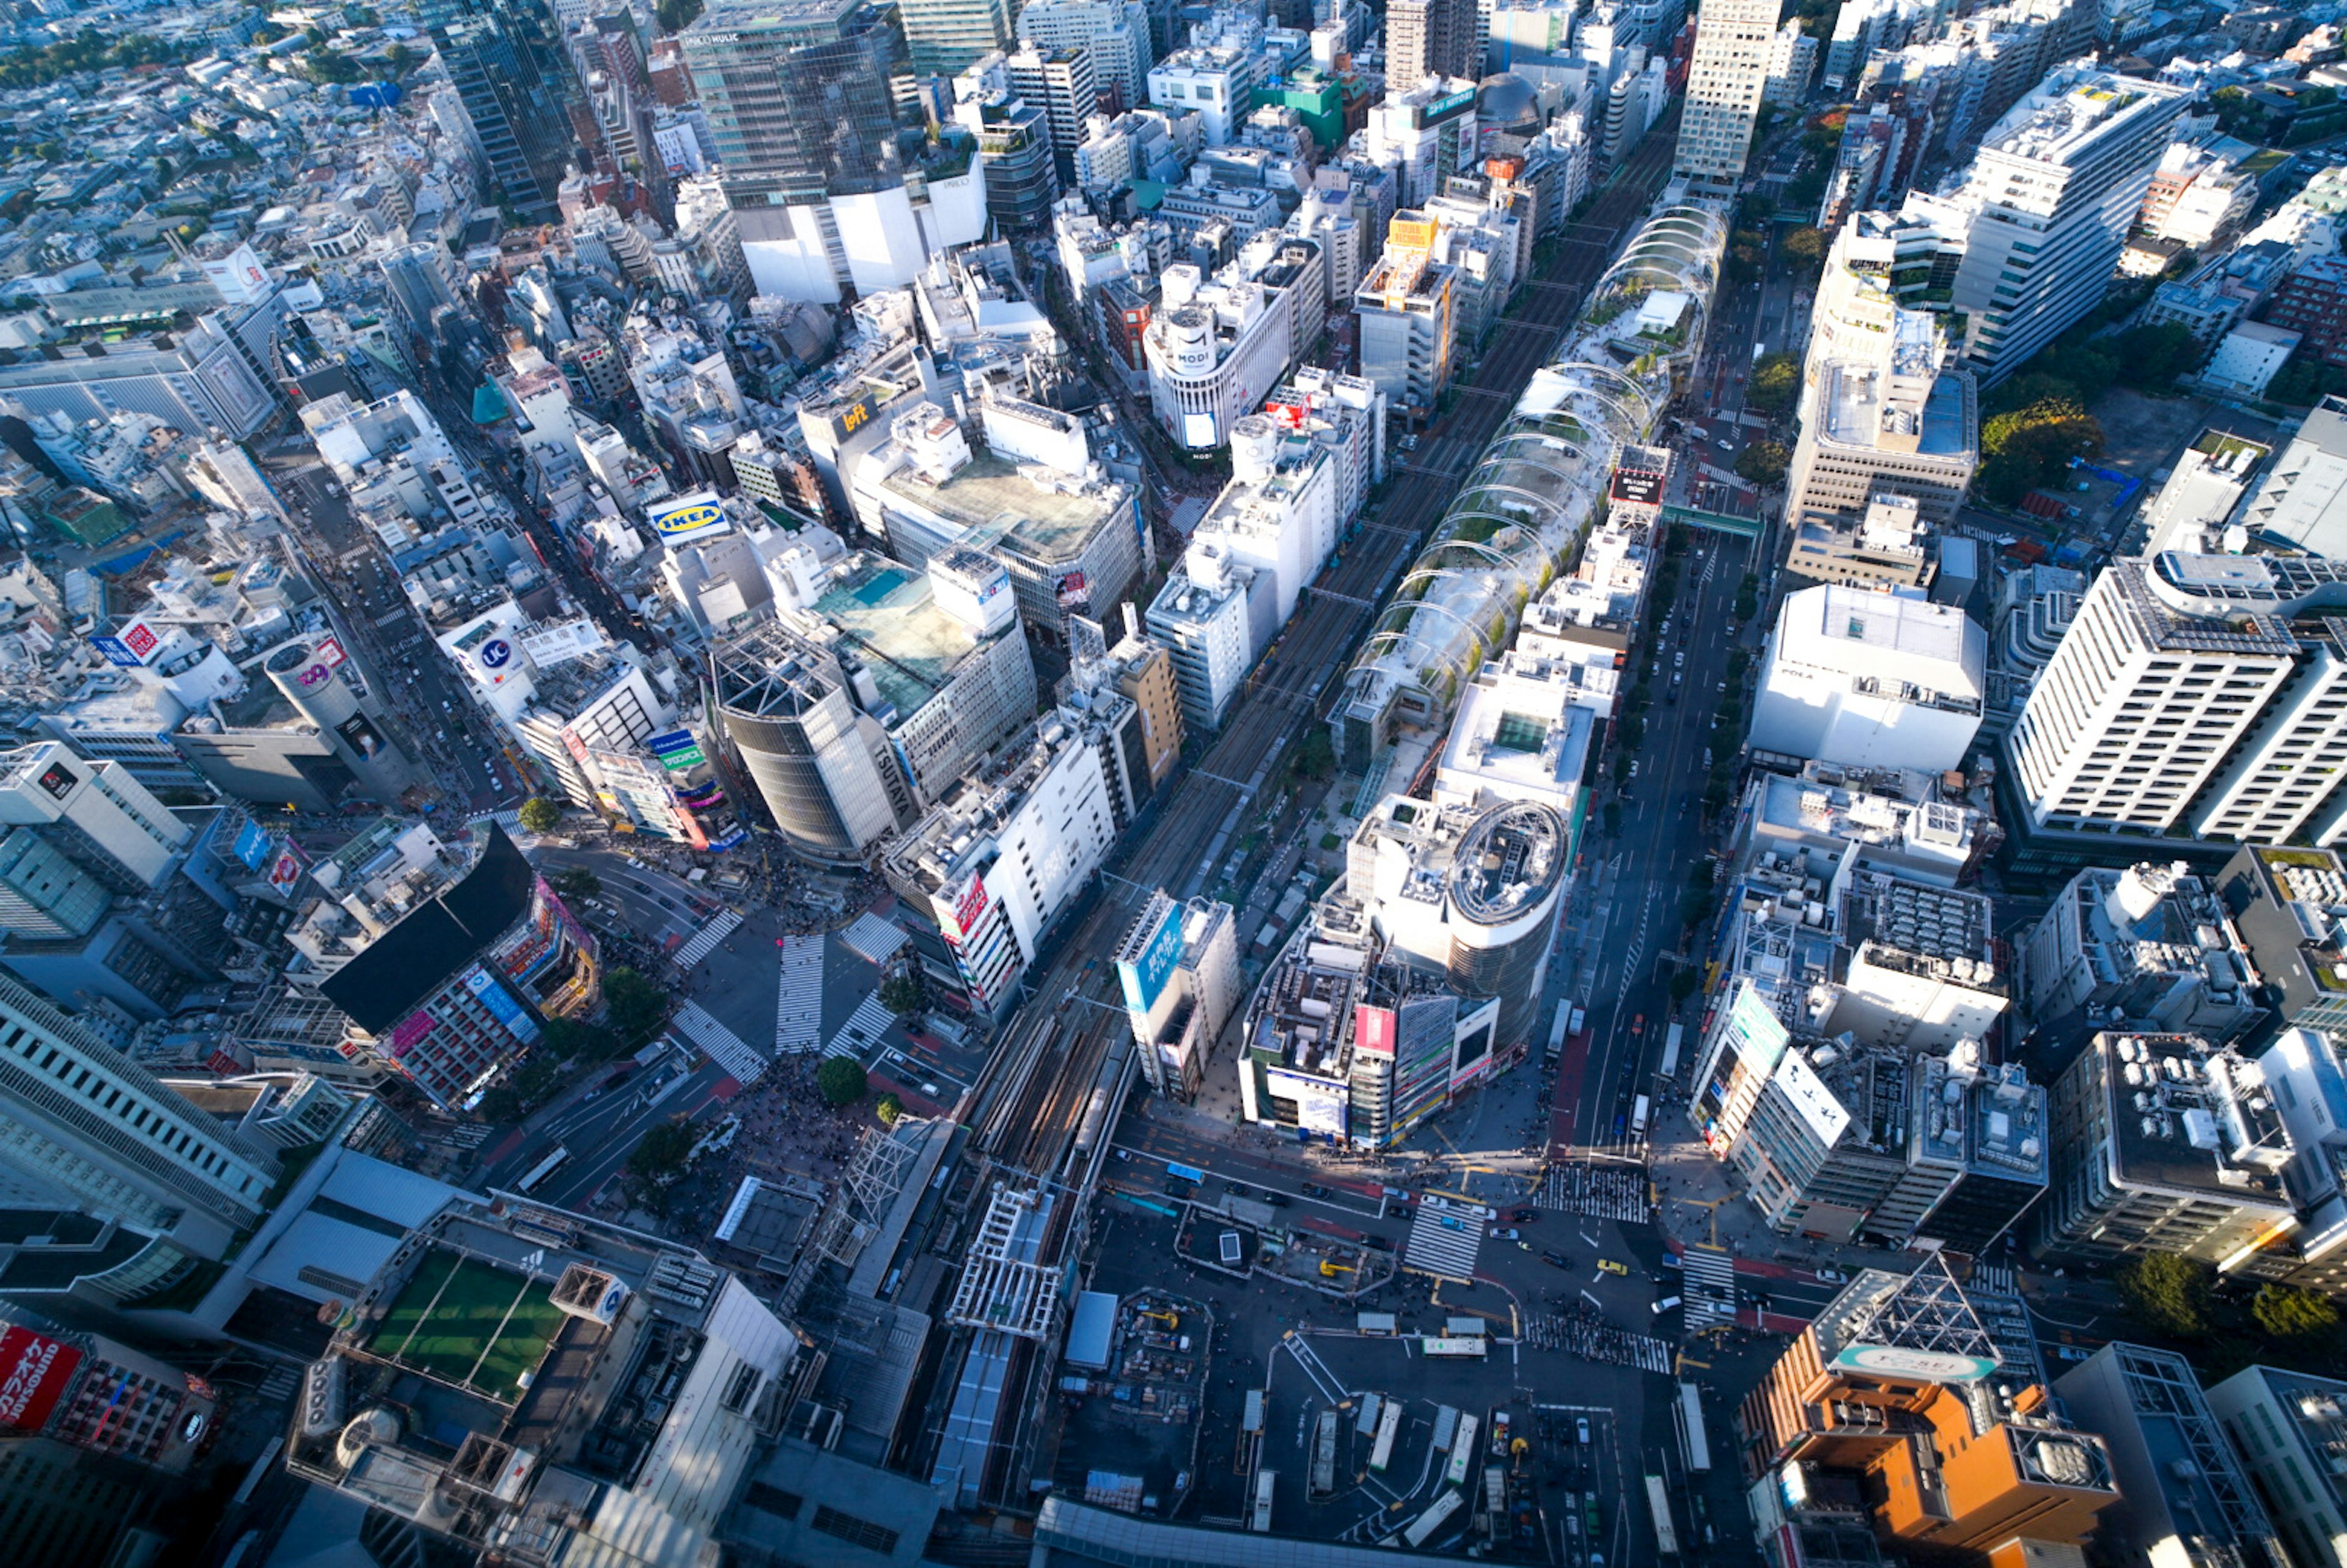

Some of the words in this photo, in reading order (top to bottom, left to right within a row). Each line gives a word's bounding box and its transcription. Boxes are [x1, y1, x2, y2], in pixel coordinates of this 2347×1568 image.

[711, 33, 738, 43] HULIC
[1178, 351, 1209, 363] MODI
[662, 509, 716, 529] IKEA
[483, 641, 509, 665] UC
[1782, 669, 1813, 680] POLA
[875, 744, 909, 817] TSUTAYA
[1790, 1064, 1837, 1127] ちふれ
[0, 1338, 43, 1415] カラオケ
[9, 1343, 59, 1420] JOYSOUND
